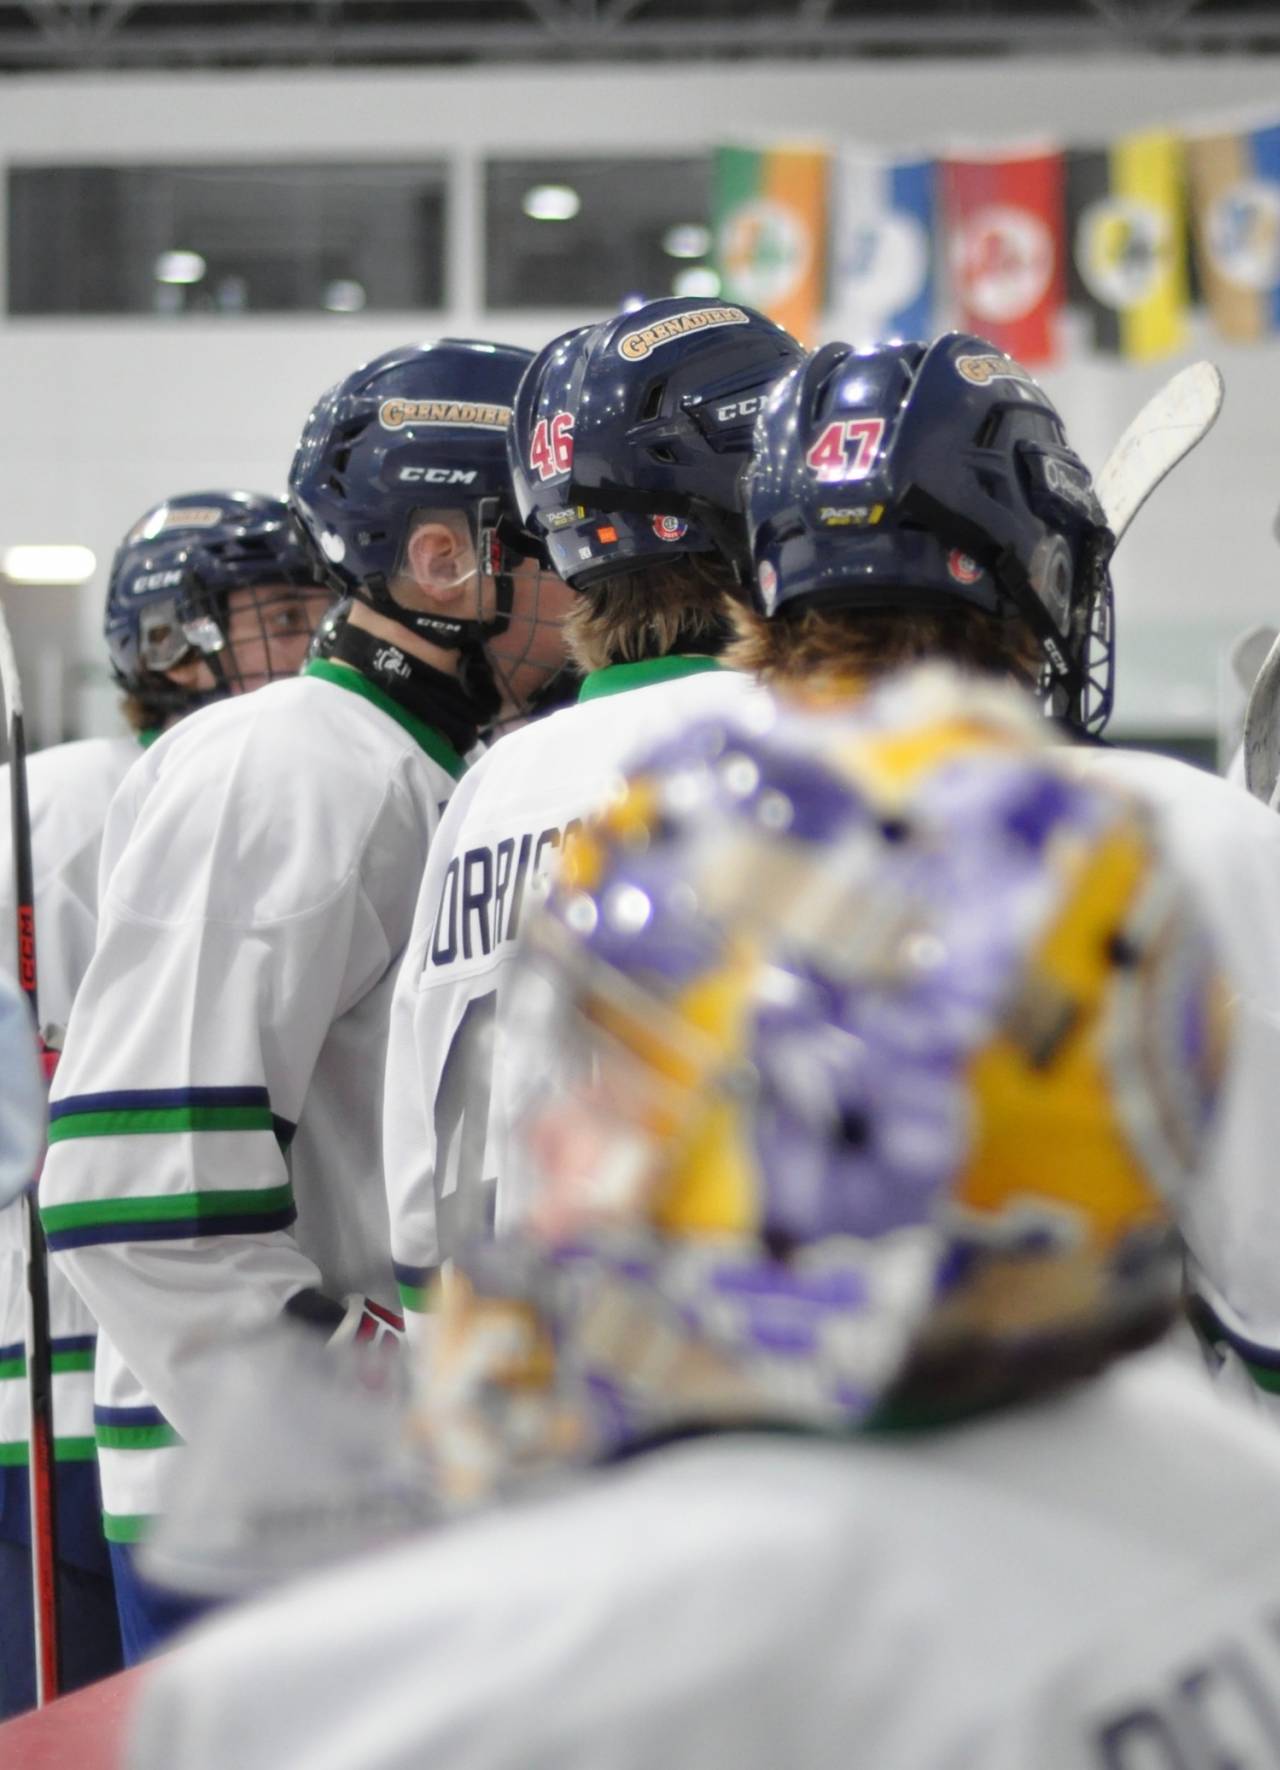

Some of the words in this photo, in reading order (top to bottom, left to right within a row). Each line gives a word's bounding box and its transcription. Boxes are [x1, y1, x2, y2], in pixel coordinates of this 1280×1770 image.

[530, 412, 576, 481] 46
[806, 418, 885, 482] 47
[400, 466, 478, 485] CCM
[132, 569, 183, 594] CCM
[1043, 637, 1069, 676] CCM
[16, 904, 37, 992] CCM
